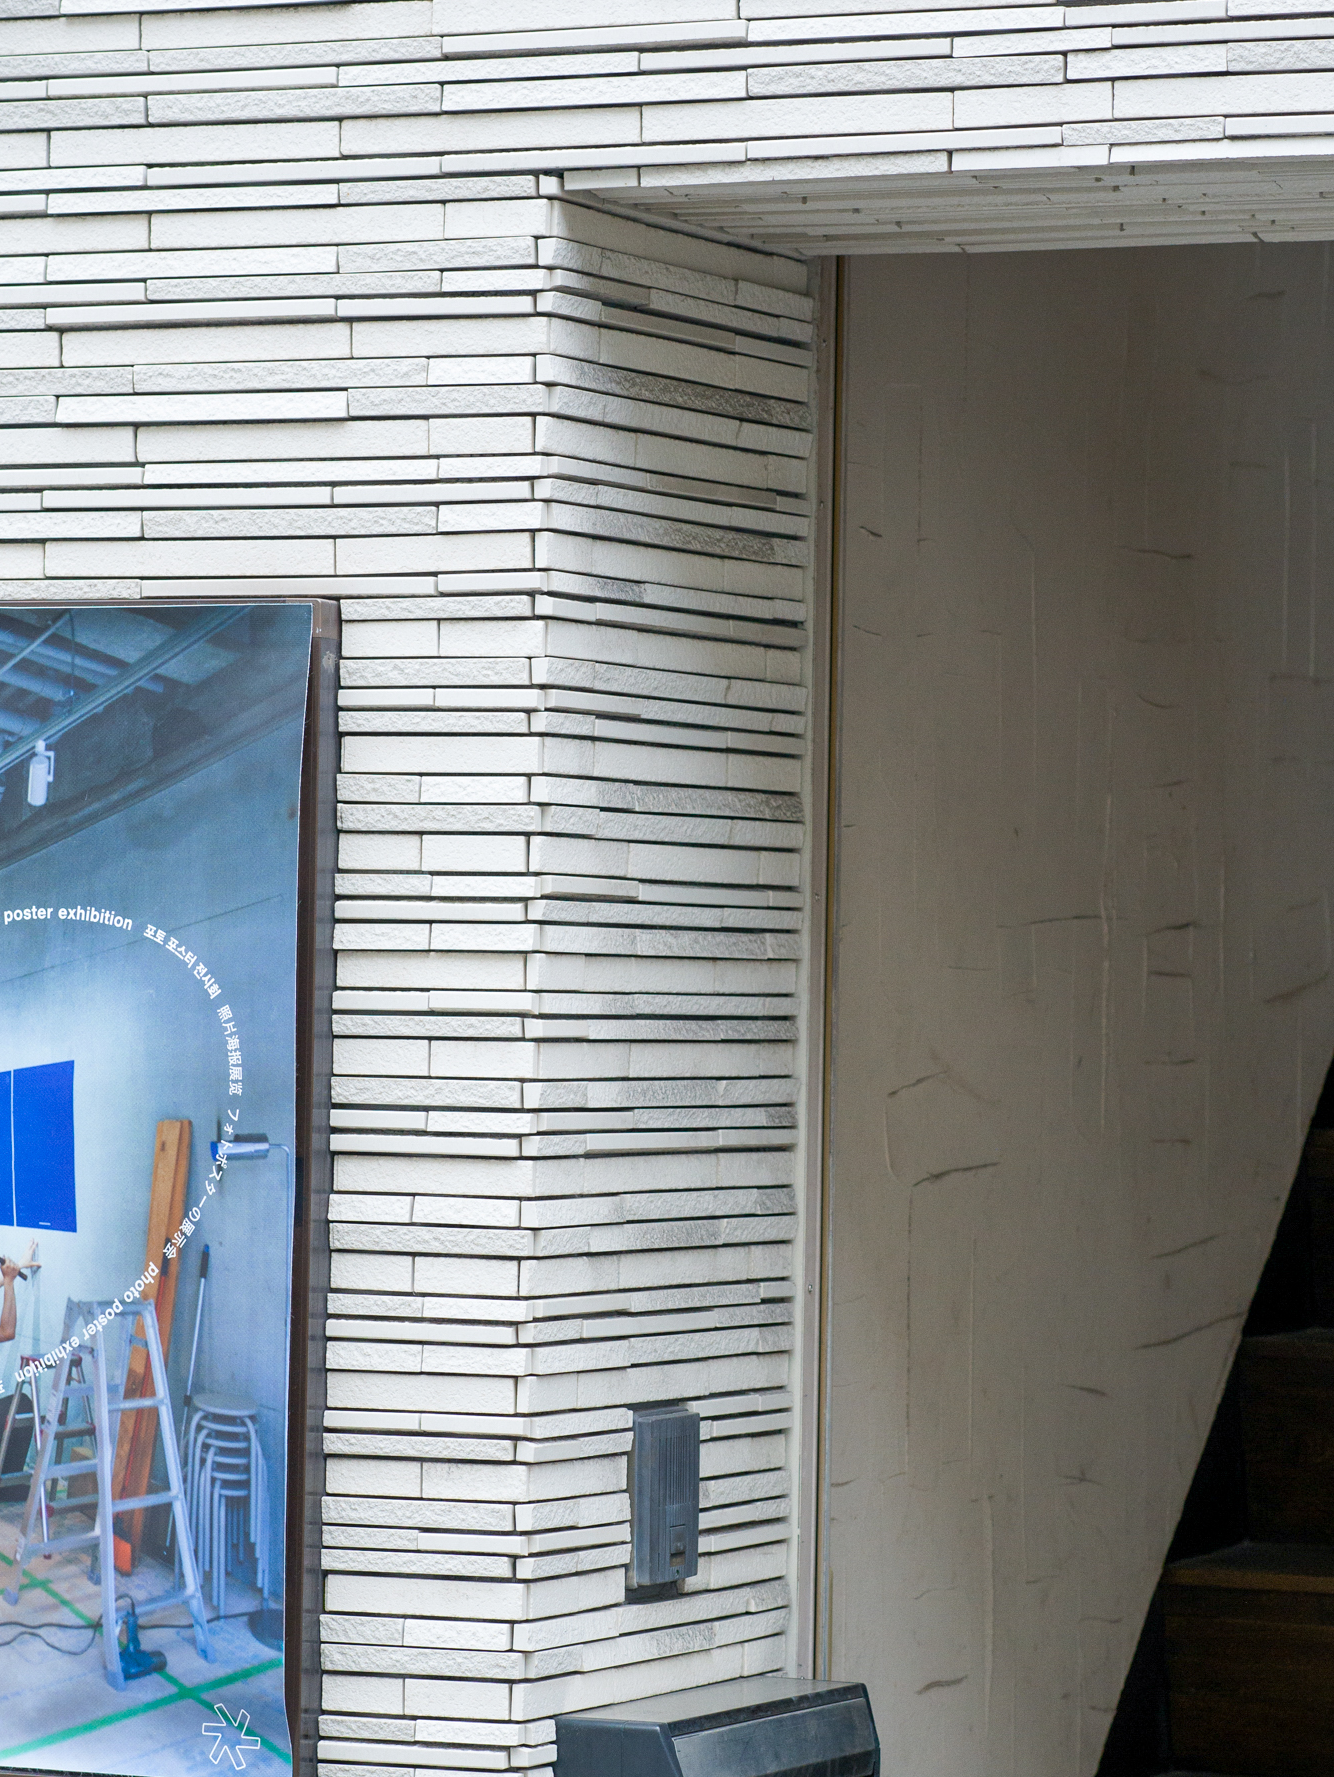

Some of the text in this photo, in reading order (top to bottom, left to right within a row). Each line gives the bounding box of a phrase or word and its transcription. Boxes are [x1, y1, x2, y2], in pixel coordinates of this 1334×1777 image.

[3, 905, 54, 925] poster
[58, 905, 133, 931] exhibition
[143, 924, 222, 1000] 포토 포스터 전시회
[217, 1004, 243, 1096] 照片海报展览
[162, 1108, 240, 1259] フォトポスターの展示会
[14, 1261, 160, 1383] photo poster exhibition
